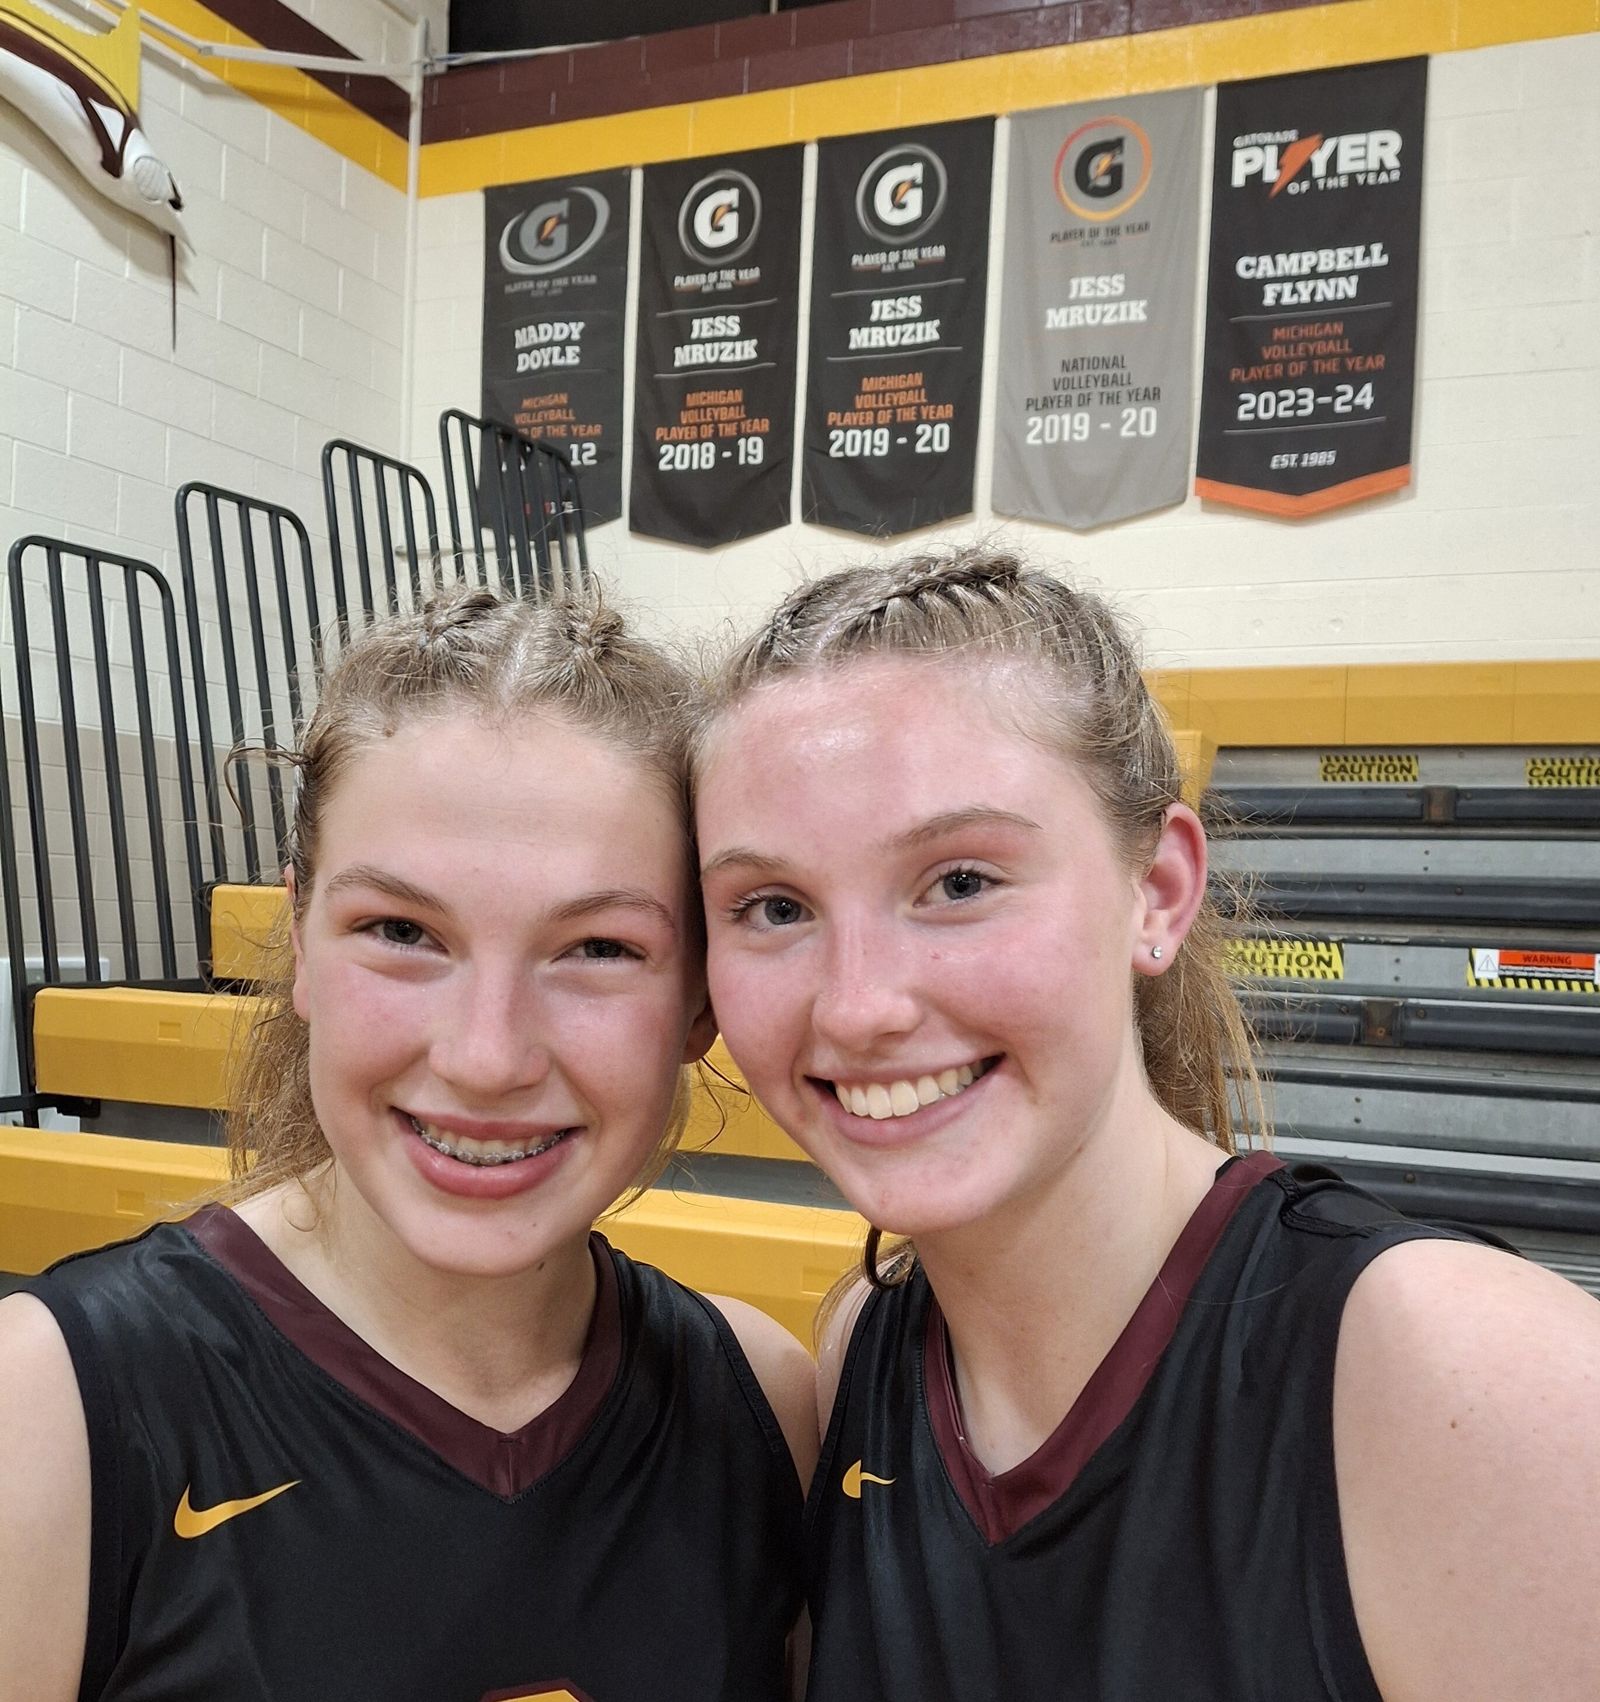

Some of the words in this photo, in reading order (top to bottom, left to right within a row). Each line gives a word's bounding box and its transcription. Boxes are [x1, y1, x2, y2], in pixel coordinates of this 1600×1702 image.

[1075, 137, 1124, 198] G
[874, 162, 923, 226] G
[1287, 180, 1310, 195] OF
[1318, 175, 1349, 191] THE
[1356, 169, 1401, 186] YEAR
[520, 198, 569, 260] G
[694, 188, 739, 248] G
[851, 251, 887, 267] PLAYER
[888, 250, 900, 264] OF
[902, 248, 919, 260] THE
[921, 245, 946, 258] YEAR
[1235, 242, 1389, 280] CAMPBELL
[674, 273, 707, 288] PLAYER
[707, 271, 718, 283] OF
[720, 269, 736, 281] THE
[738, 266, 760, 280] YEAR
[1069, 273, 1126, 299] JESS
[1262, 275, 1359, 306] FLYNN
[870, 295, 922, 322] JESS
[1045, 300, 1148, 329] MRUZIK
[514, 321, 585, 349] MADDY
[690, 315, 741, 339] JESS
[848, 319, 940, 350] MRUZIK
[1272, 321, 1344, 341] MICHIGAN
[516, 346, 580, 373] DOYLE
[674, 339, 758, 367] MRUZIK
[1261, 339, 1352, 360] VOLLEYBALL
[1061, 355, 1127, 373] NATIONAL
[1230, 363, 1283, 382] PLAYER
[1288, 361, 1307, 377] OF
[1313, 358, 1339, 374] THE
[1346, 354, 1386, 371] YEAR
[862, 372, 923, 391] MICHIGAN
[1053, 372, 1132, 391] VOLLEYBALL
[522, 393, 568, 409] MICHIGAN
[686, 389, 743, 406] MICHIGAN
[855, 388, 927, 409] VOLLEYBALL
[1025, 394, 1072, 411] PLAYER
[1078, 392, 1093, 407] OF
[1099, 390, 1121, 405] THE
[1127, 386, 1161, 402] YEAR
[1237, 382, 1375, 422] 2023-24
[514, 409, 576, 424] VOLLEYBALL
[680, 405, 746, 424] VOLLEYBALL
[827, 411, 874, 426] PLAYER
[877, 409, 892, 424] OF
[896, 407, 918, 422] THE
[921, 404, 954, 420] YEAR
[1026, 412, 1090, 445] 2019
[1120, 406, 1157, 438] 20
[531, 426, 544, 438] OF
[546, 425, 567, 437] THE
[571, 424, 602, 436] YEAR
[656, 425, 698, 441] PLAYER
[700, 424, 714, 439] OF
[718, 422, 738, 437] THE
[740, 418, 770, 434] YEAR
[829, 428, 890, 458] 2019
[915, 423, 950, 453] 20
[569, 442, 597, 466] 12
[658, 442, 716, 471] 2018
[738, 436, 764, 465] 19
[1322, 761, 1414, 776] CAUTION
[1522, 954, 1572, 966] WARNING
